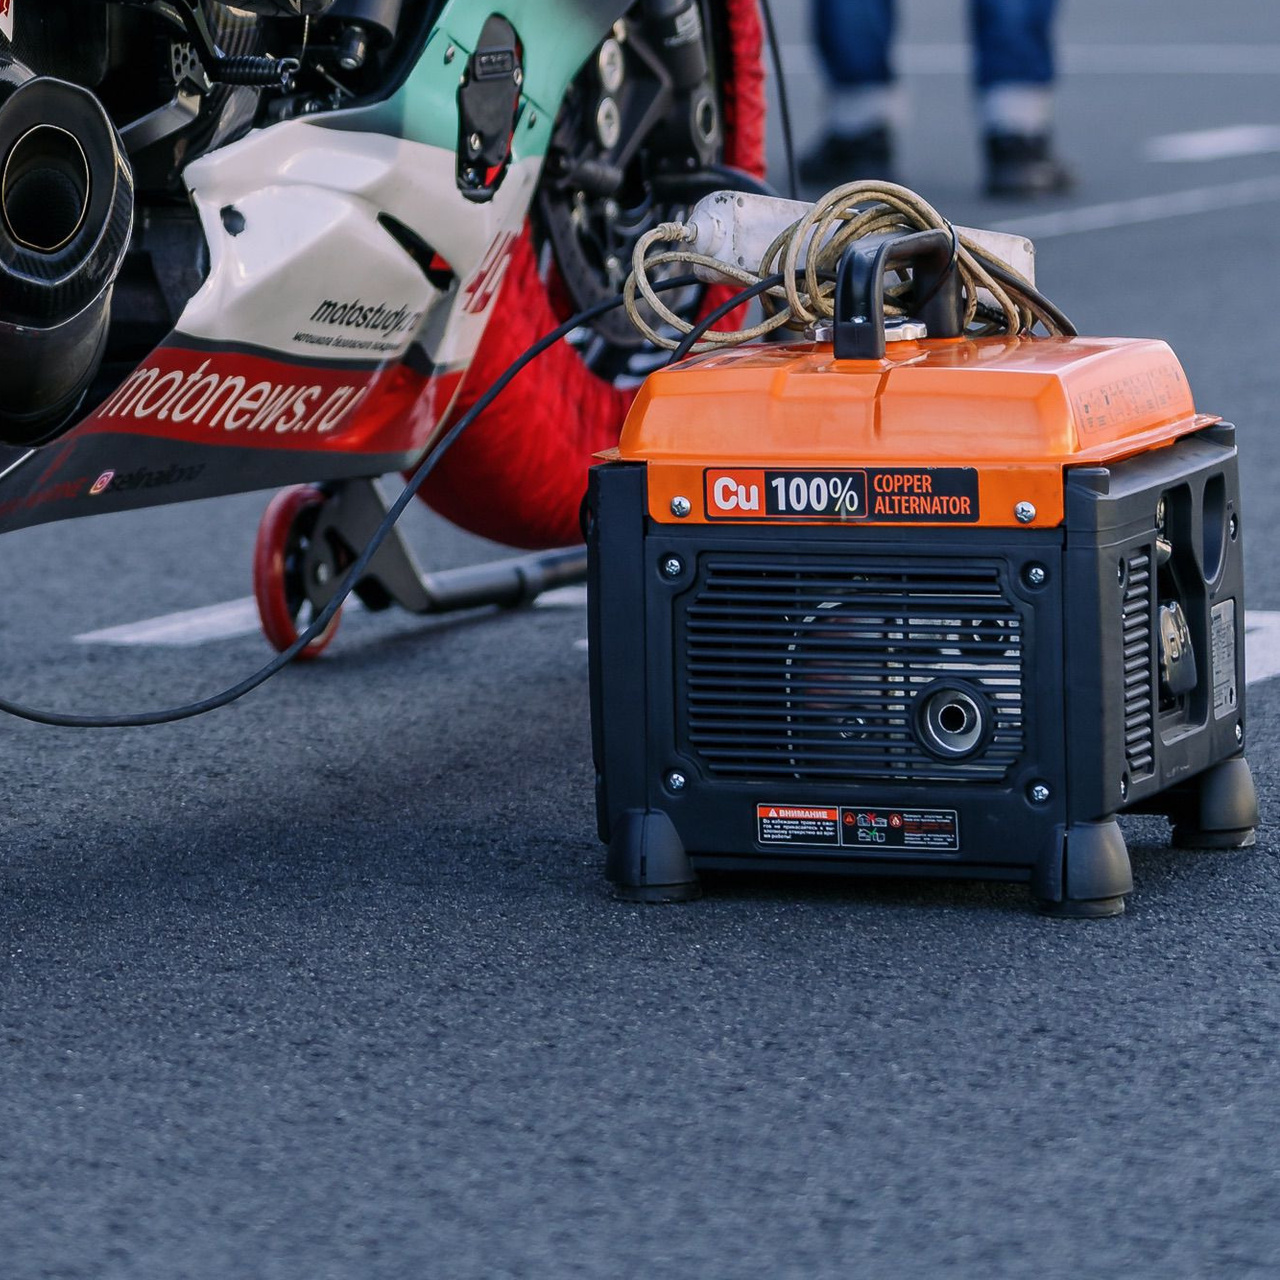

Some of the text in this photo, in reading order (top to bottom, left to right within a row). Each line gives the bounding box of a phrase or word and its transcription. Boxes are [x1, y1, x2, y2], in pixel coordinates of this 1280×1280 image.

[97, 358, 368, 433] motonews.ru
[873, 474, 933, 493] COPPER
[713, 476, 859, 512] Cu 100%
[873, 495, 972, 515] ALTERNATOR
[779, 809, 828, 819] ВНИМАНИЕ
